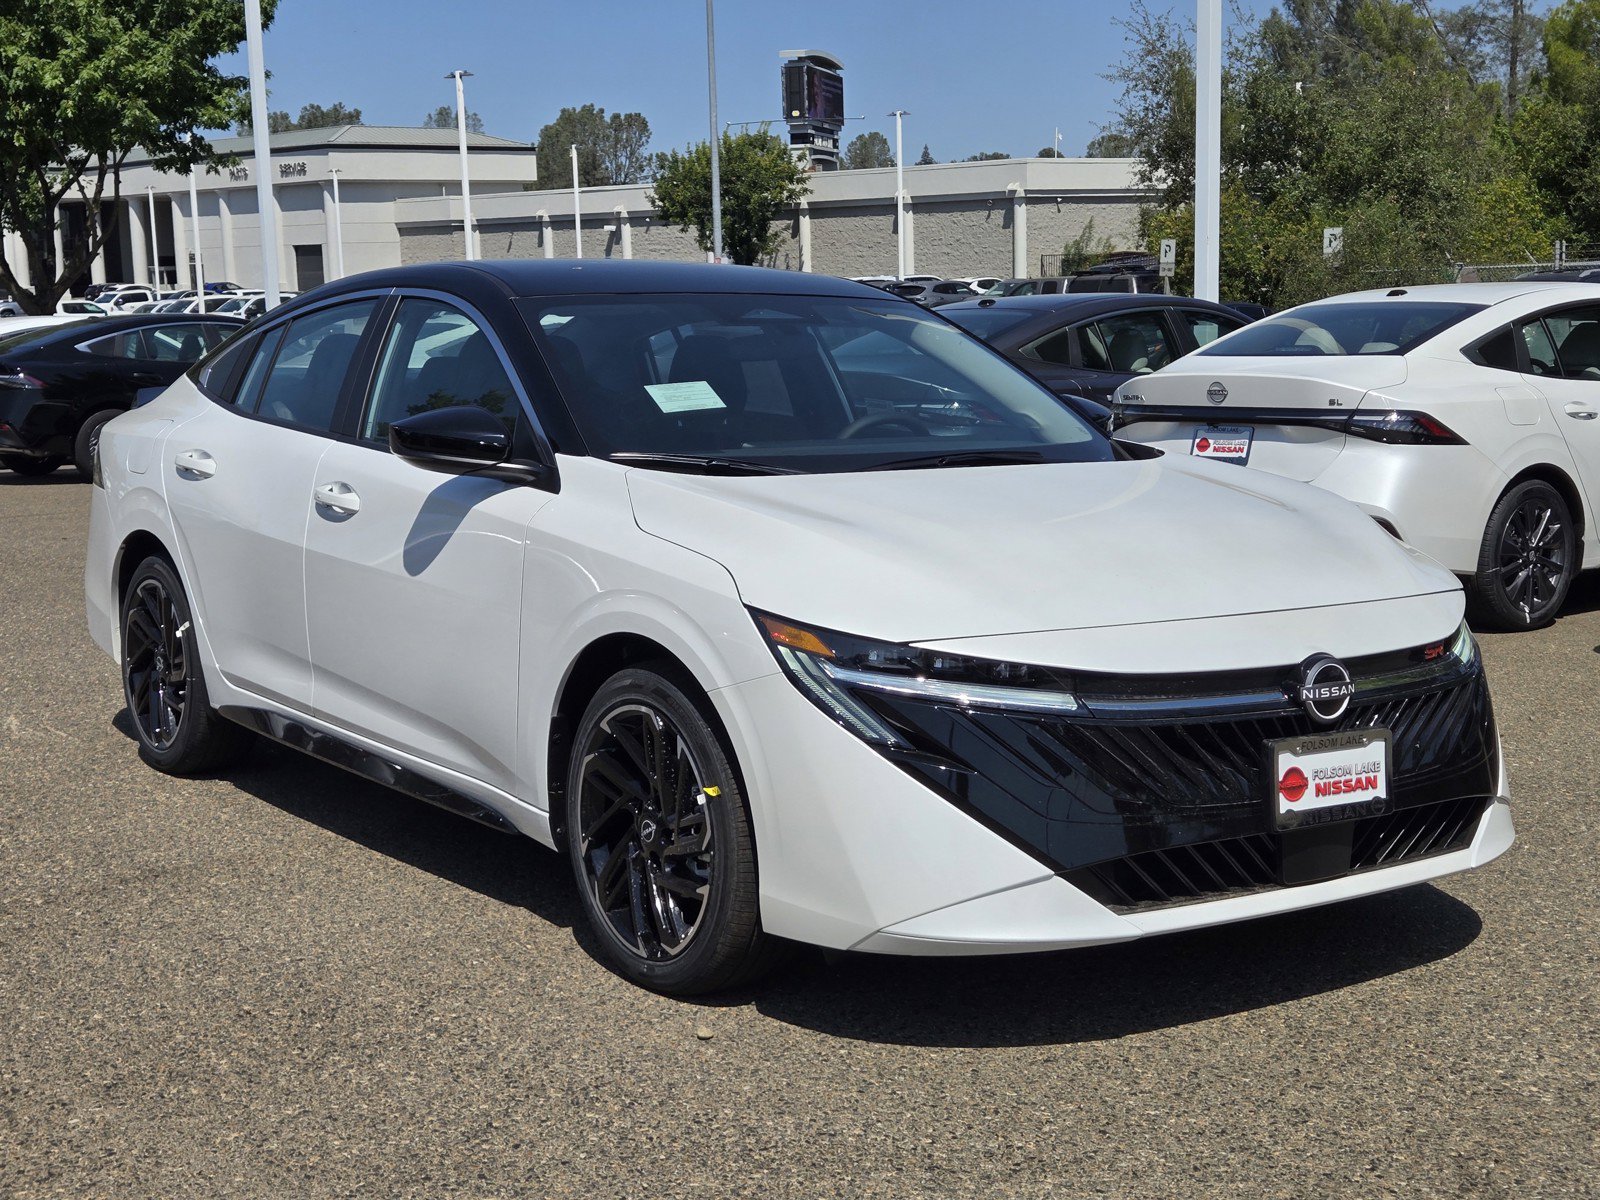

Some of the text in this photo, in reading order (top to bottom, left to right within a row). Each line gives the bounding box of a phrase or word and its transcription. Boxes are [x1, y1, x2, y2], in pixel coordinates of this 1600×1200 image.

[279, 162, 306, 176] SERVICE
[1425, 644, 1444, 660] SR
[1303, 683, 1355, 699] NISSAN
[1301, 735, 1364, 751] FOLSOM LAKE
[1312, 761, 1381, 780] FOLSOM LAKE
[1314, 775, 1378, 797] NISSAN
[1303, 804, 1367, 824] NISSAN
